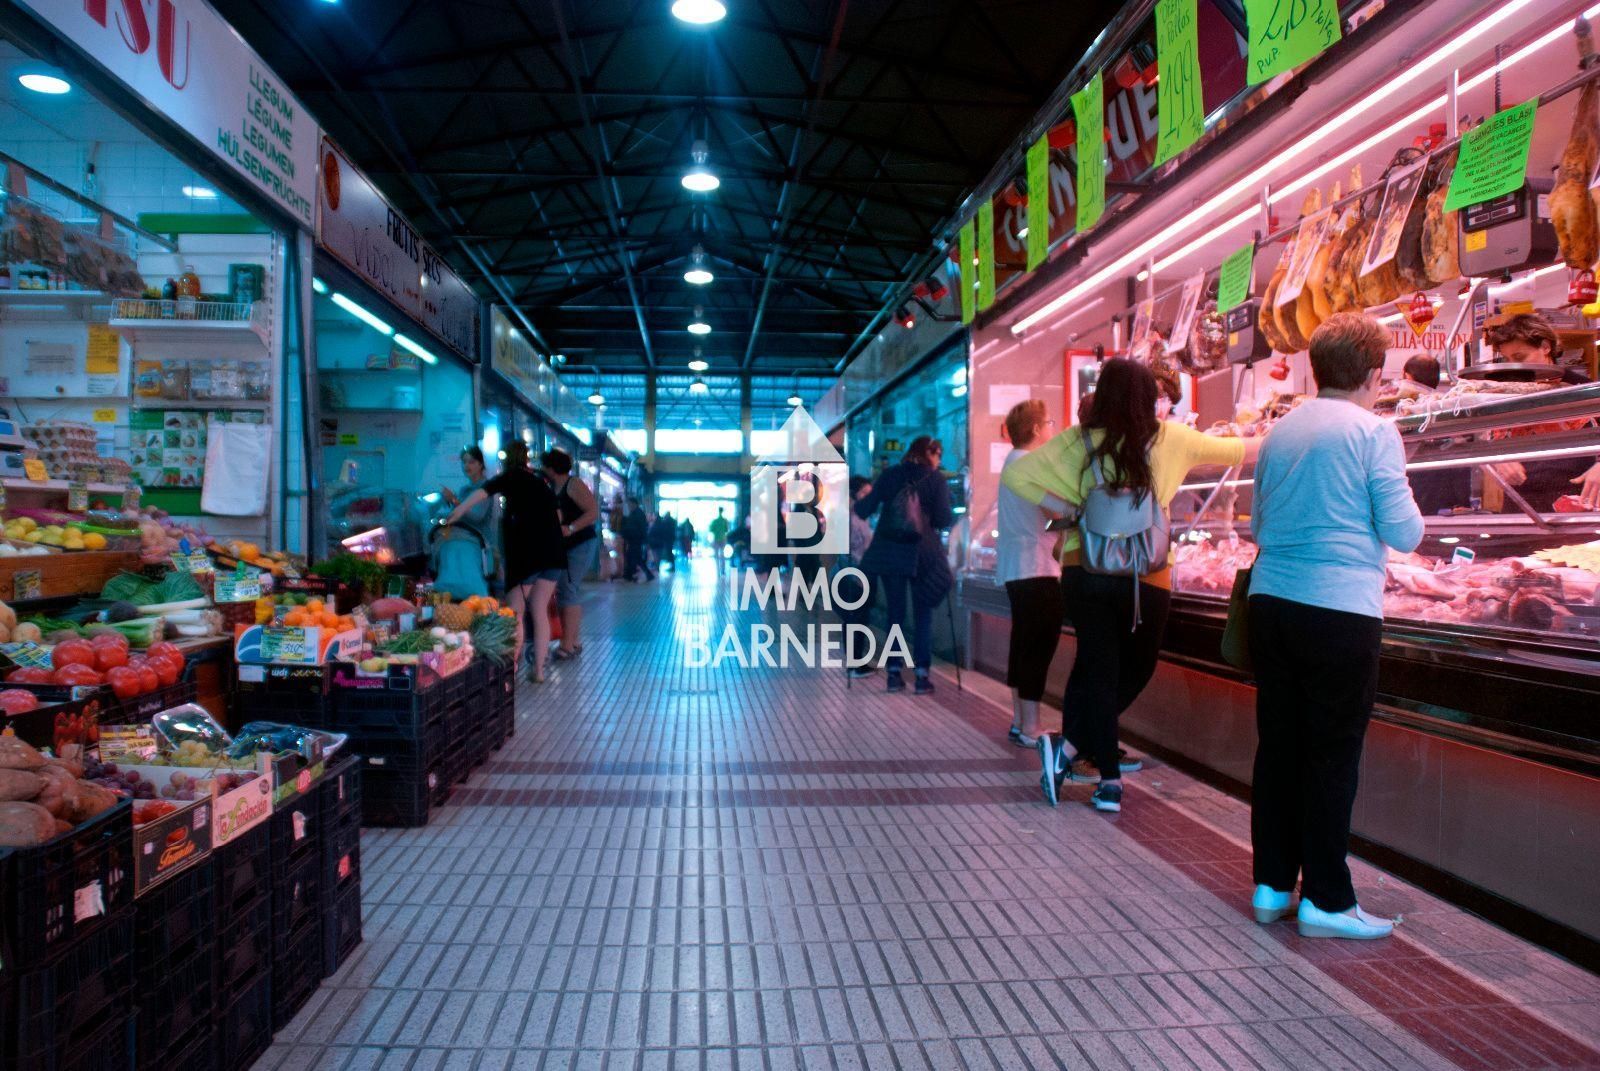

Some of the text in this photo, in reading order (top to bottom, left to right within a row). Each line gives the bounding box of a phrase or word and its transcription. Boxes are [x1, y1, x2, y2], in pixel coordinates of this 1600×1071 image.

[247, 92, 292, 150] LÉGUME
[249, 64, 293, 123] LLEGUM
[242, 118, 295, 180] LEGUMEN
[387, 207, 441, 285] FRUITS SECS
